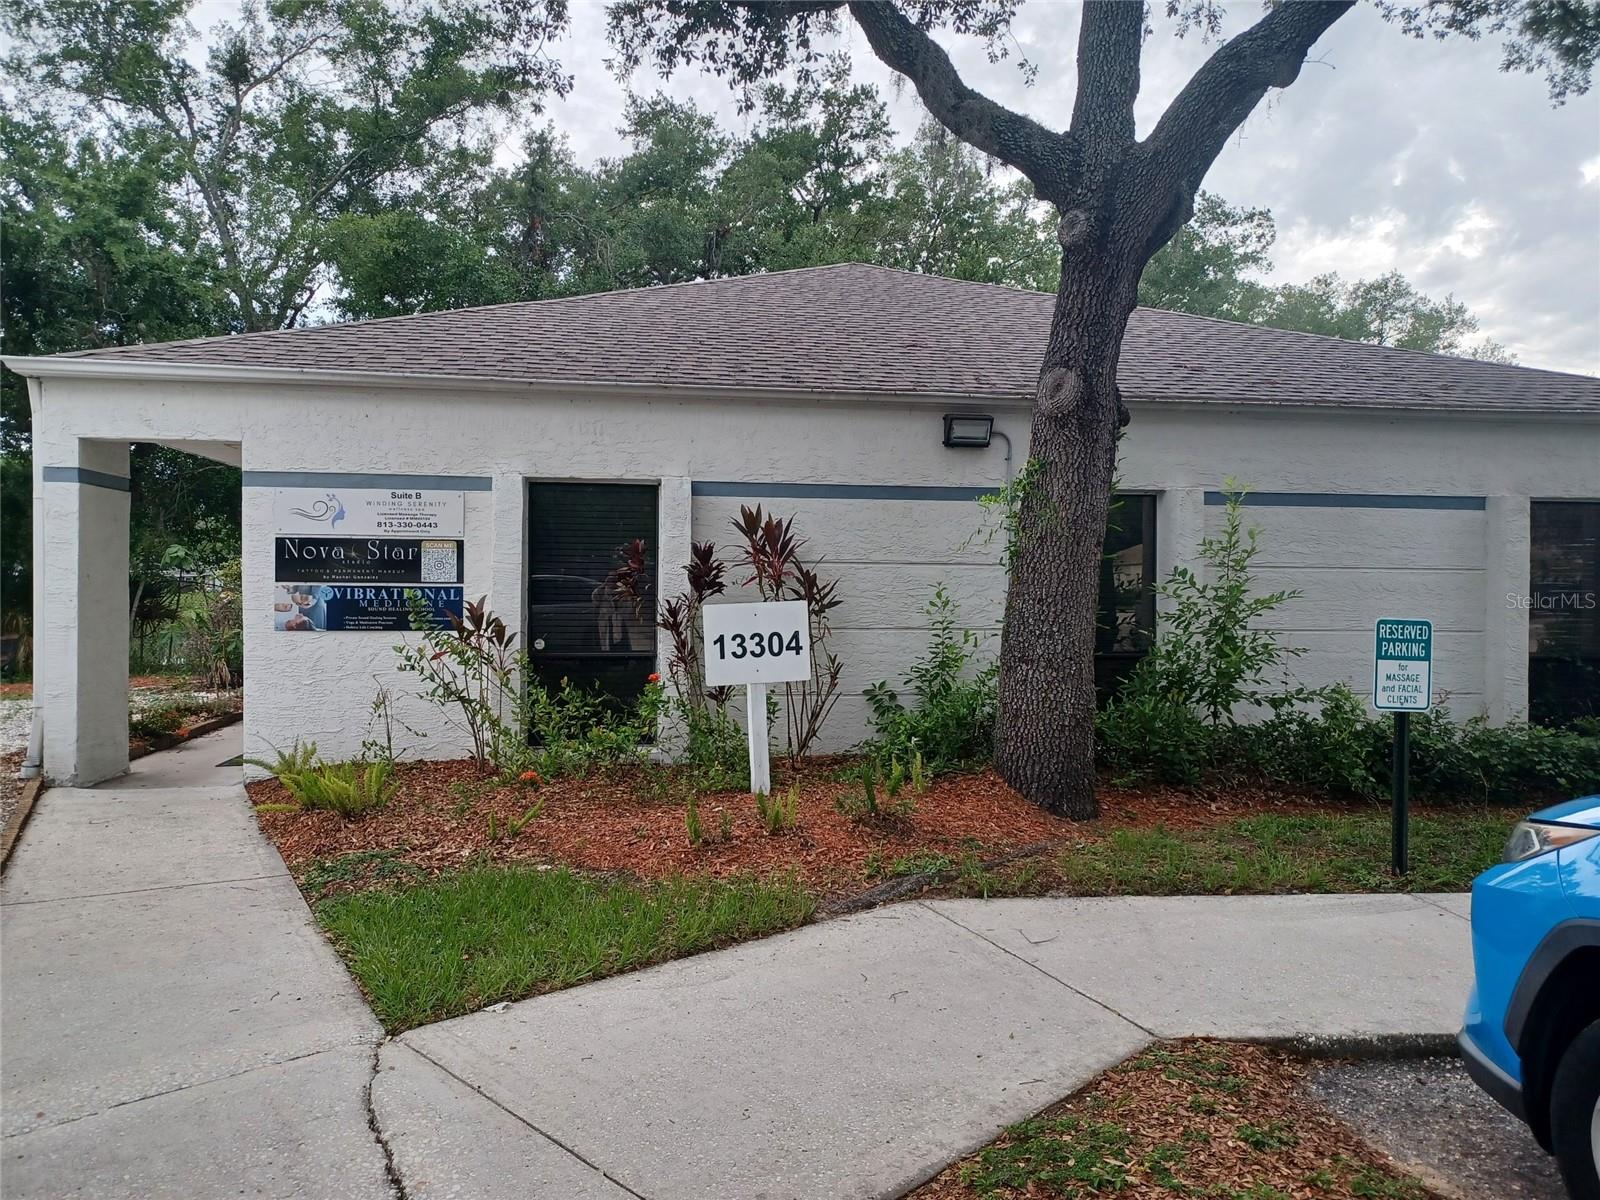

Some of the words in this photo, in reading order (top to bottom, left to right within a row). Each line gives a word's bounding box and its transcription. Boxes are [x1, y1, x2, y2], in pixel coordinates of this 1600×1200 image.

[284, 539, 345, 559] Nova
[367, 540, 418, 560] Star
[333, 588, 460, 600] VIBRATIONAL
[359, 599, 445, 608] MEDICNE
[1379, 624, 1429, 640] RESERVED
[713, 630, 803, 660] 13304
[1381, 641, 1425, 657] PARKING
[1398, 662, 1408, 671] for
[1385, 673, 1420, 682] MASSAGE
[1381, 684, 1395, 692] and
[1397, 684, 1423, 693] FACIAL
[1387, 694, 1417, 704] CLIENTS
